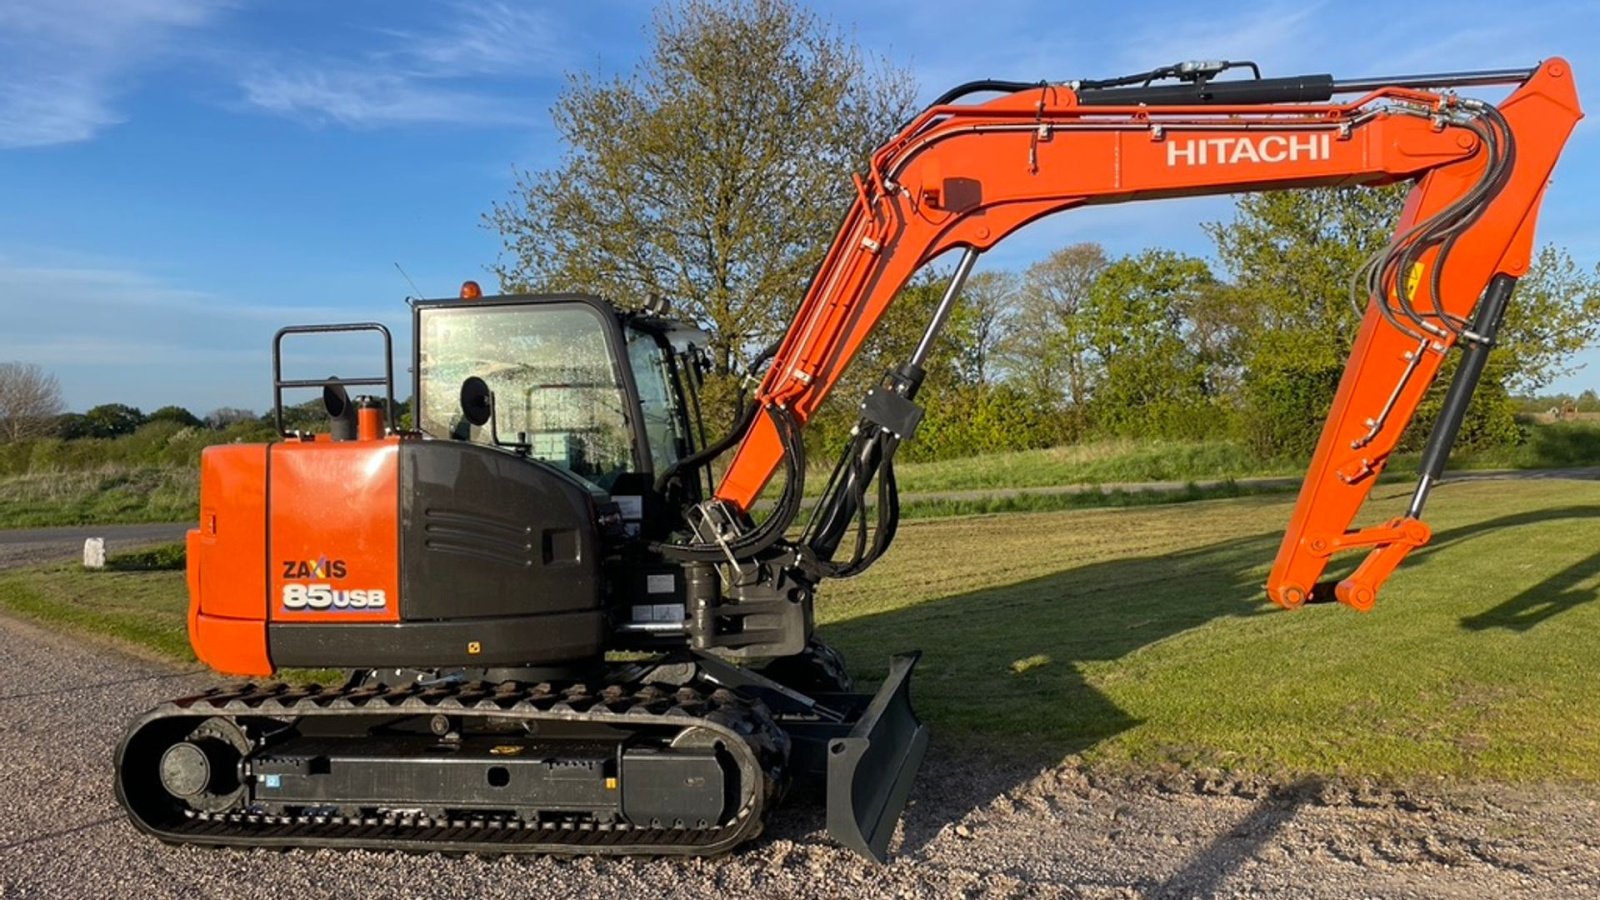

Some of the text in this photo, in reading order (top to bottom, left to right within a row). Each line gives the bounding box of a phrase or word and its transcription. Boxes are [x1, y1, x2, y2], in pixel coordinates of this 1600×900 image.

[1167, 134, 1330, 166] HITACHI
[284, 557, 347, 578] ZAXIS
[283, 584, 386, 610] 85USB
